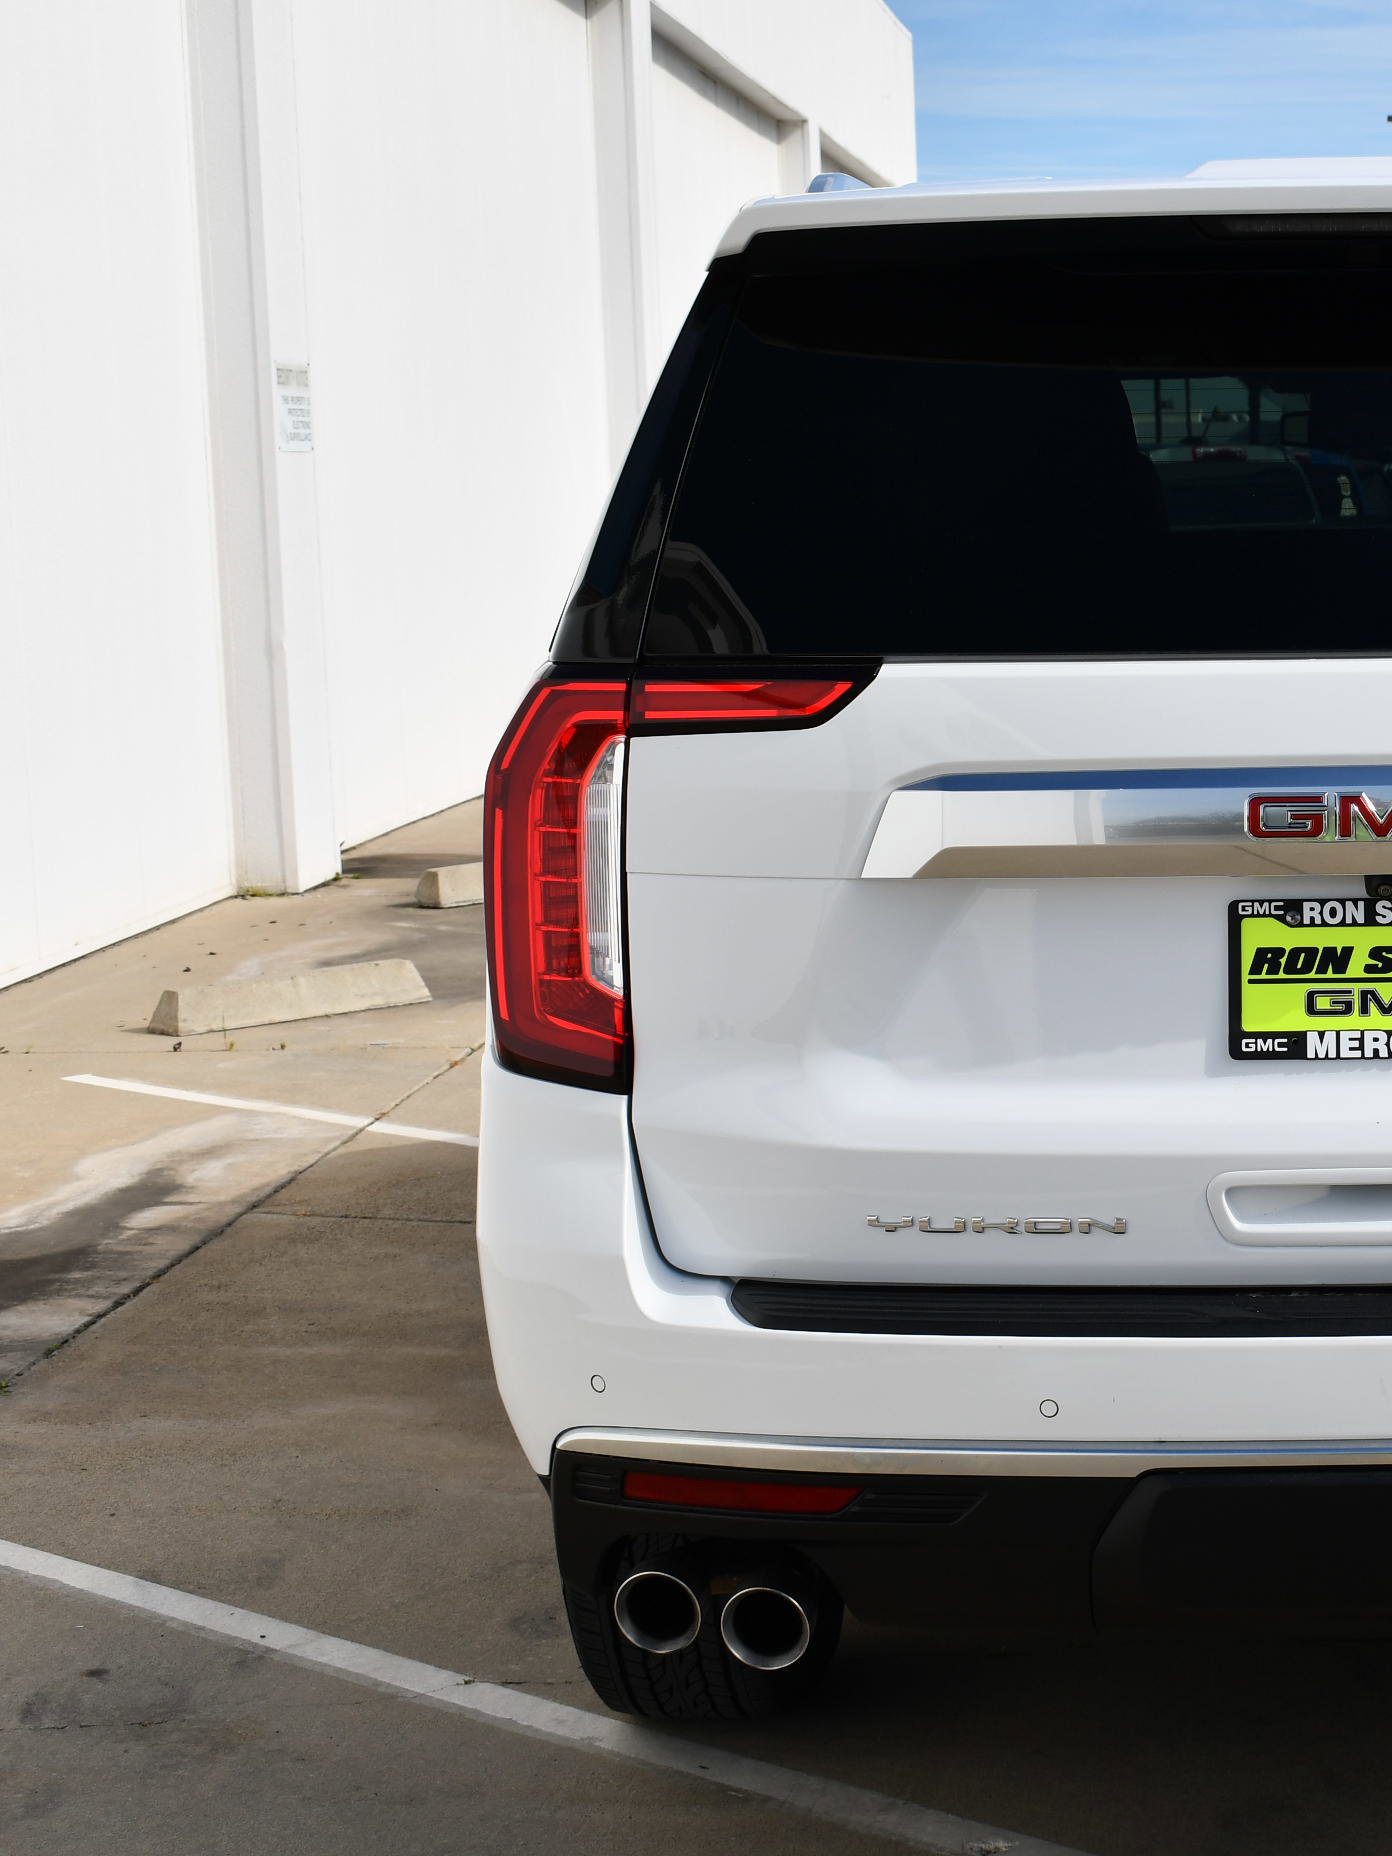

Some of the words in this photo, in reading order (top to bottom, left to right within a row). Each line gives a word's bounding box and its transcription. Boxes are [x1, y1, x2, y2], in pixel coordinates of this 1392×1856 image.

[1238, 902, 1285, 915] GMC
[1302, 901, 1365, 925] RON
[1247, 945, 1355, 976] RON
[1241, 1038, 1288, 1052] GMC
[866, 1214, 1127, 1235] YUKON
